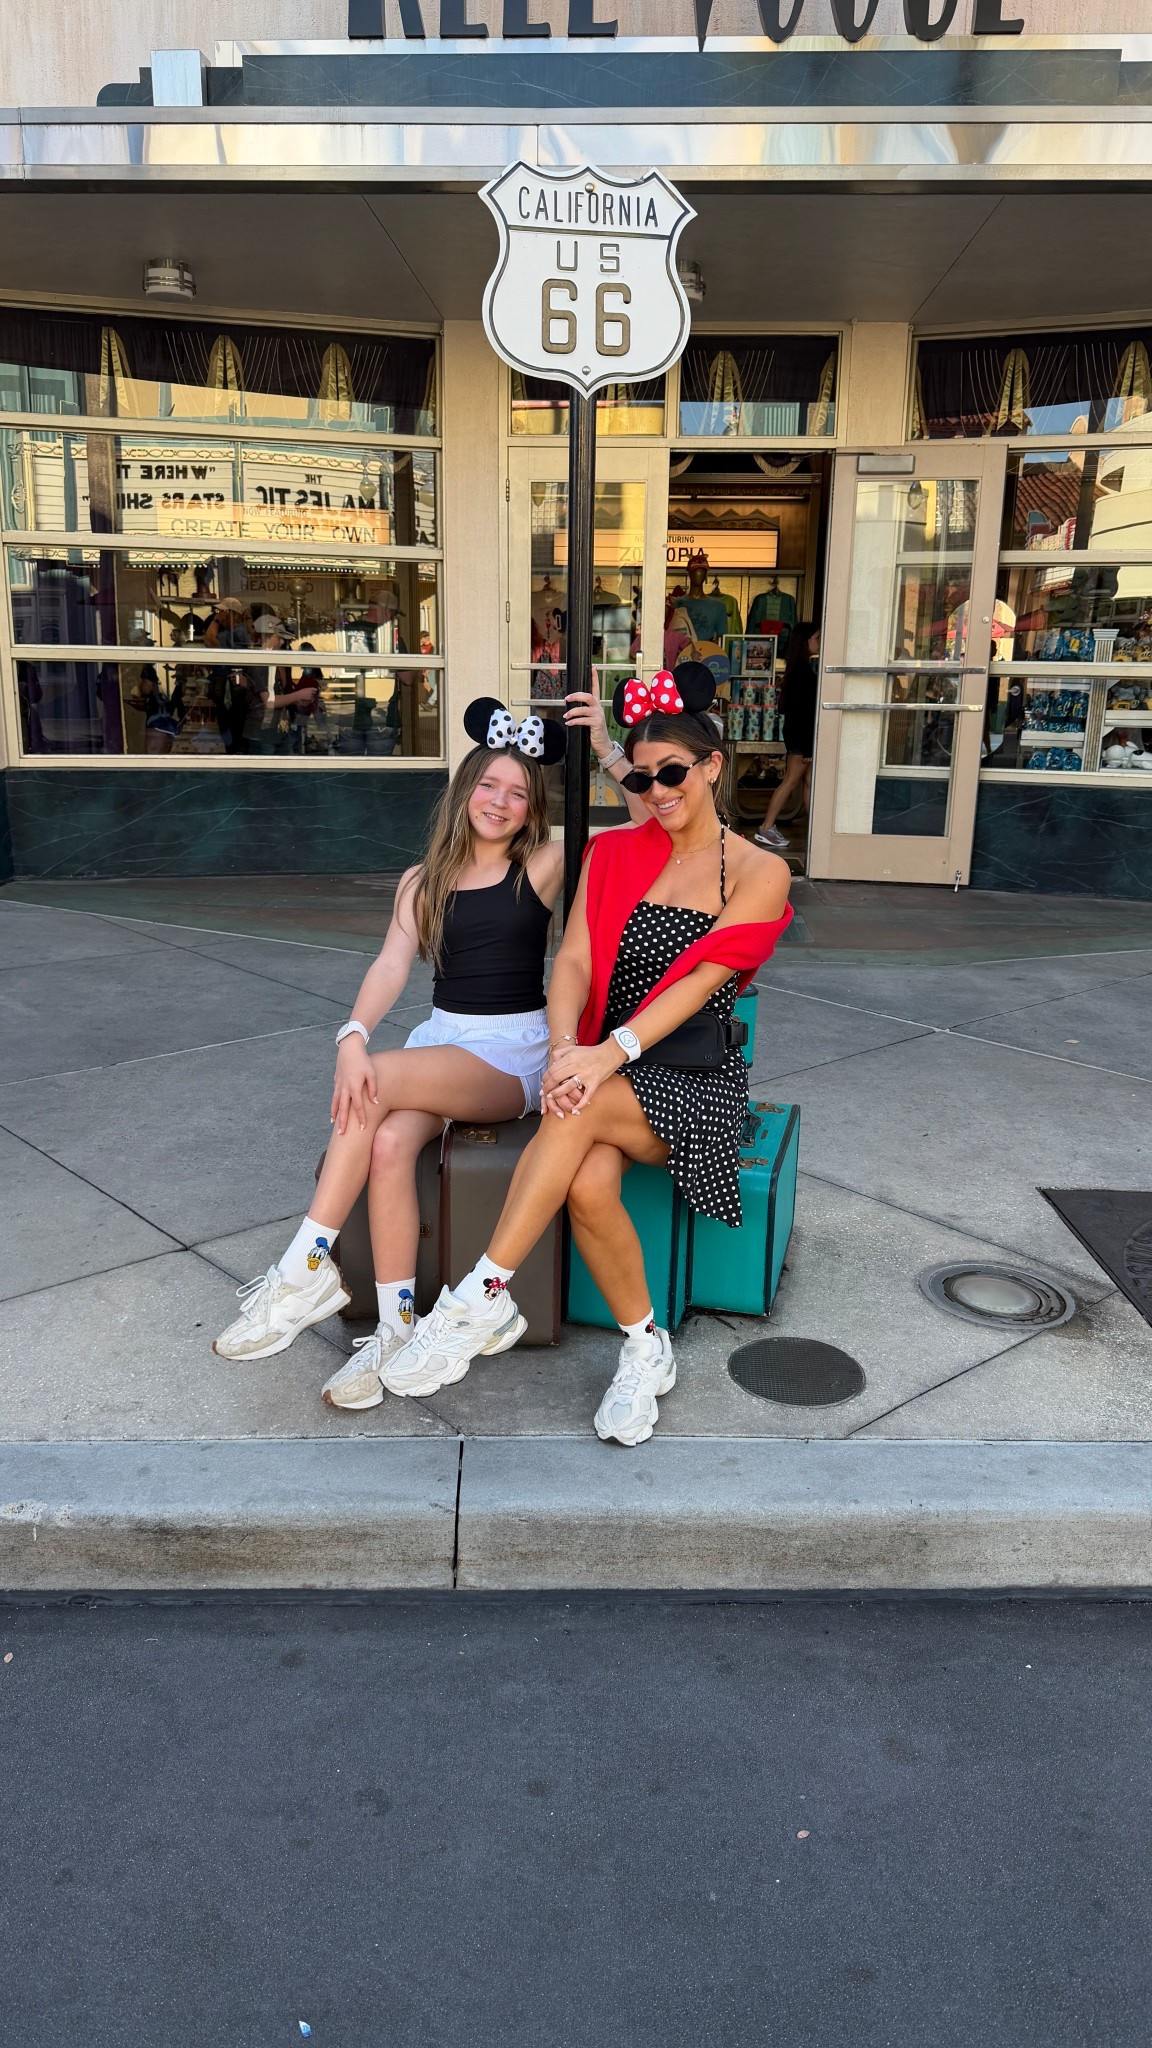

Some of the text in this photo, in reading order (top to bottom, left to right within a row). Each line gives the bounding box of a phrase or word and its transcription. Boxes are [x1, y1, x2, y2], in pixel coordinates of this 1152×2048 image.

[518, 186, 659, 228] CALIFORNIA
[541, 278, 632, 357] 66
[243, 507, 308, 518] NOW FEATURING
[171, 518, 376, 543] CREATE YOUR OWN
[240, 579, 314, 594] HEADBD
